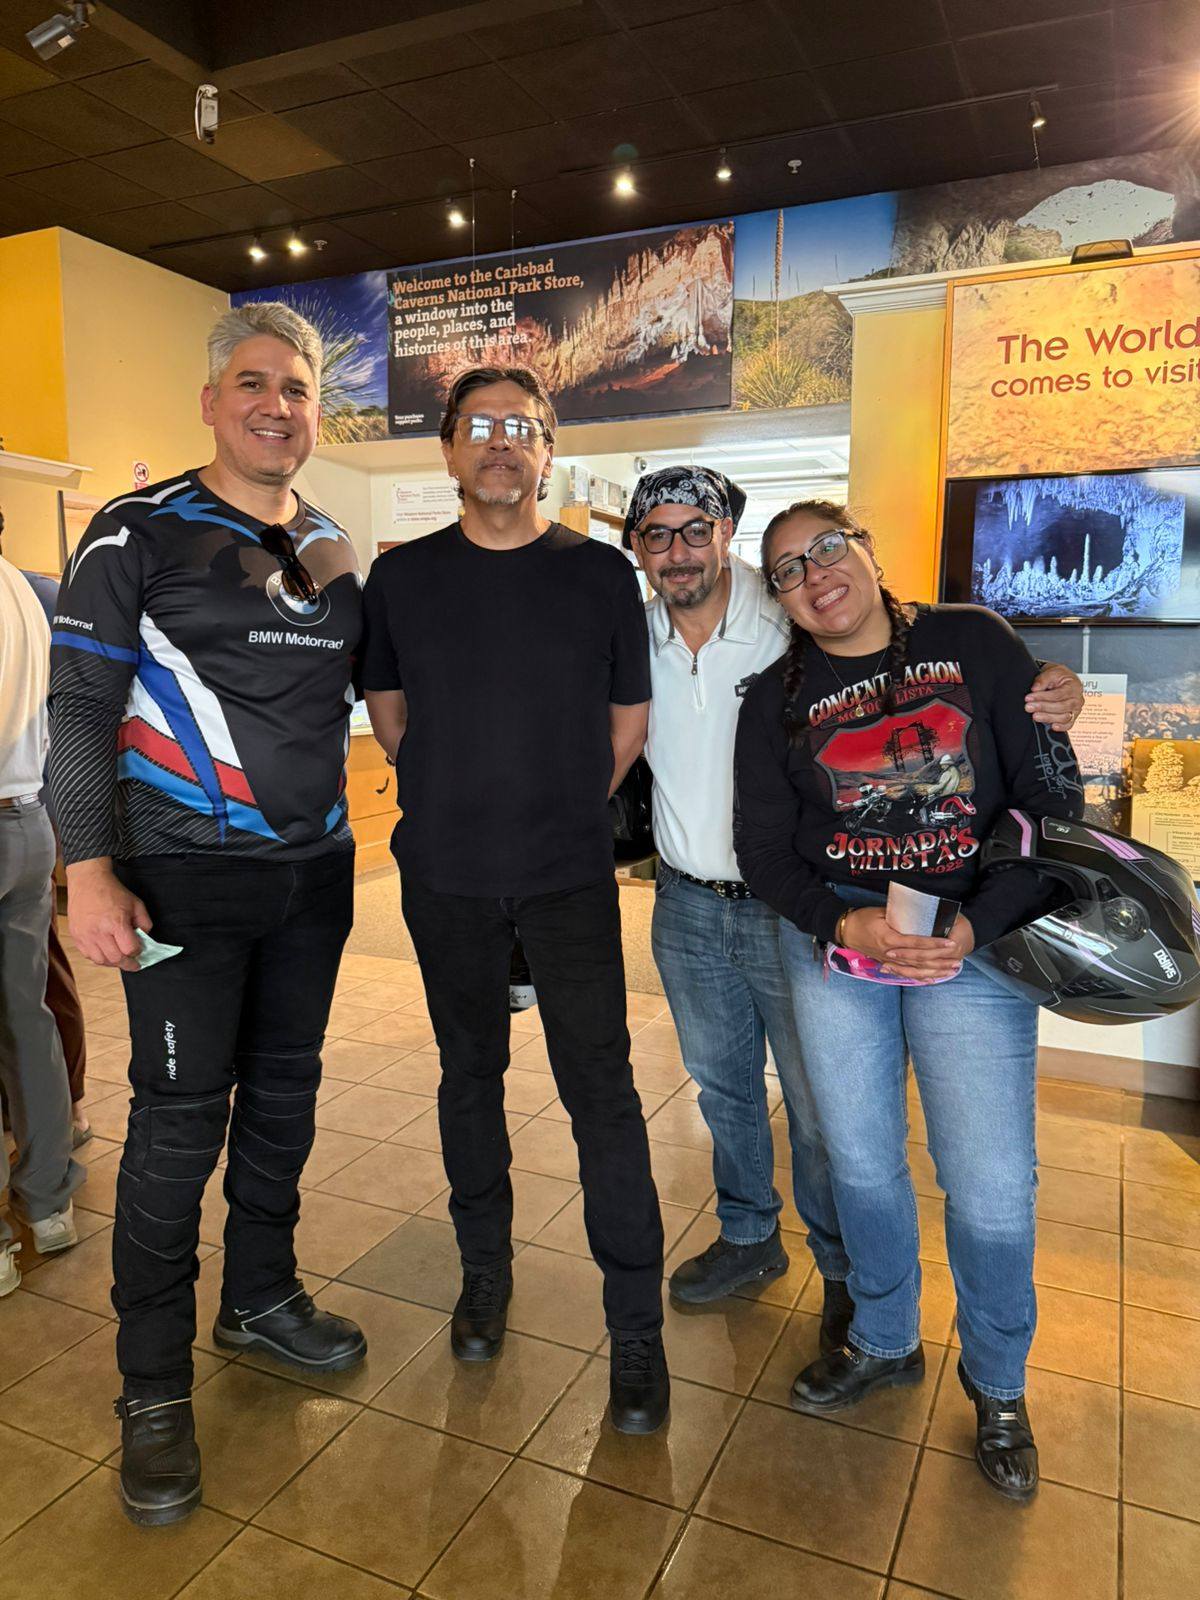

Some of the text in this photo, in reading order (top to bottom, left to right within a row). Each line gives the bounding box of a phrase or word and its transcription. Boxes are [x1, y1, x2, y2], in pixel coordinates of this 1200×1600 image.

[393, 258, 555, 294] Welcome to the Carlsbad
[394, 275, 584, 310] Caverns National Park Store,
[394, 298, 513, 326] a window into the
[394, 312, 516, 343] people, places, and
[394, 332, 532, 358] histories of this area.
[997, 316, 1200, 365] The World
[991, 372, 1091, 398] comes
[1102, 366, 1133, 389] to
[248, 630, 344, 650] BMW Motorrad
[808, 661, 964, 728] CONCENTACION
[1153, 949, 1177, 979] SHIRO
[163, 1020, 177, 1080] ride safety
